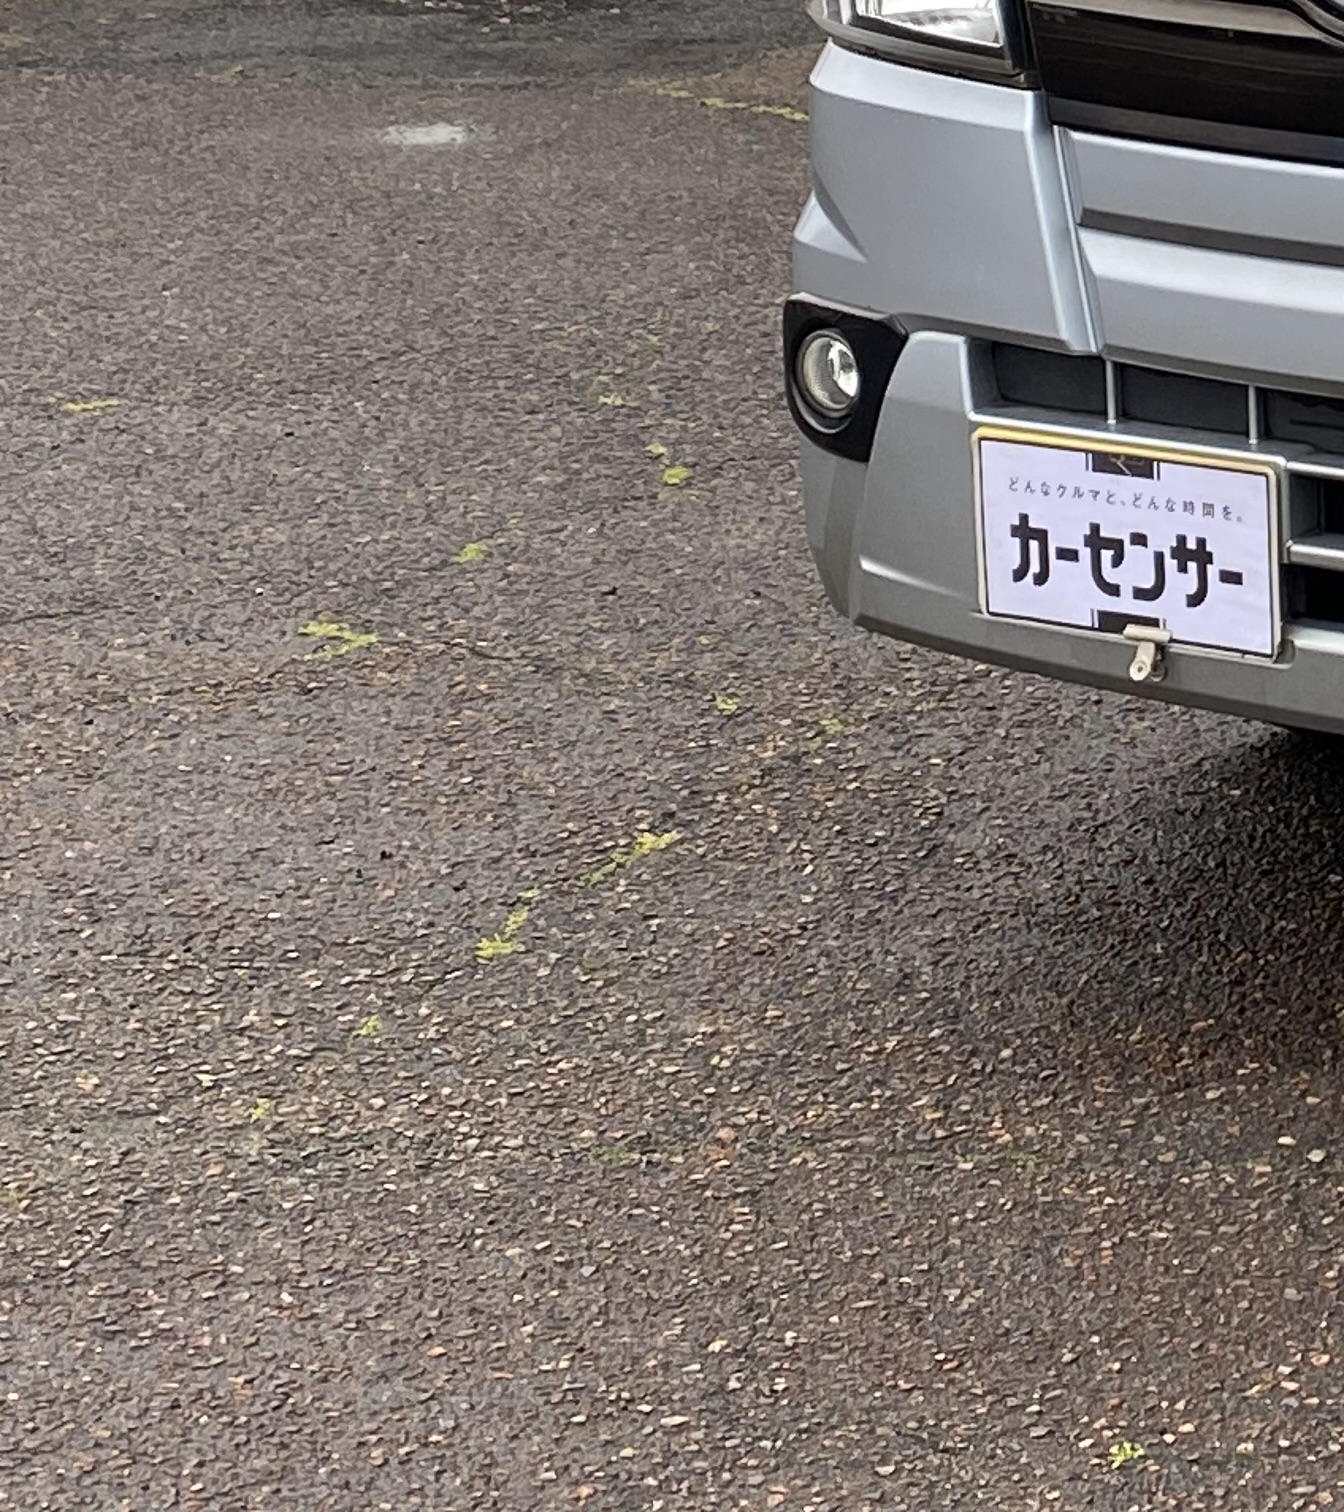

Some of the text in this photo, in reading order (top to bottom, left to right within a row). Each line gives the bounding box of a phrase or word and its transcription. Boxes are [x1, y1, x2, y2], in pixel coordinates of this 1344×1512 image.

[1009, 512, 1244, 609] カーセンサー
